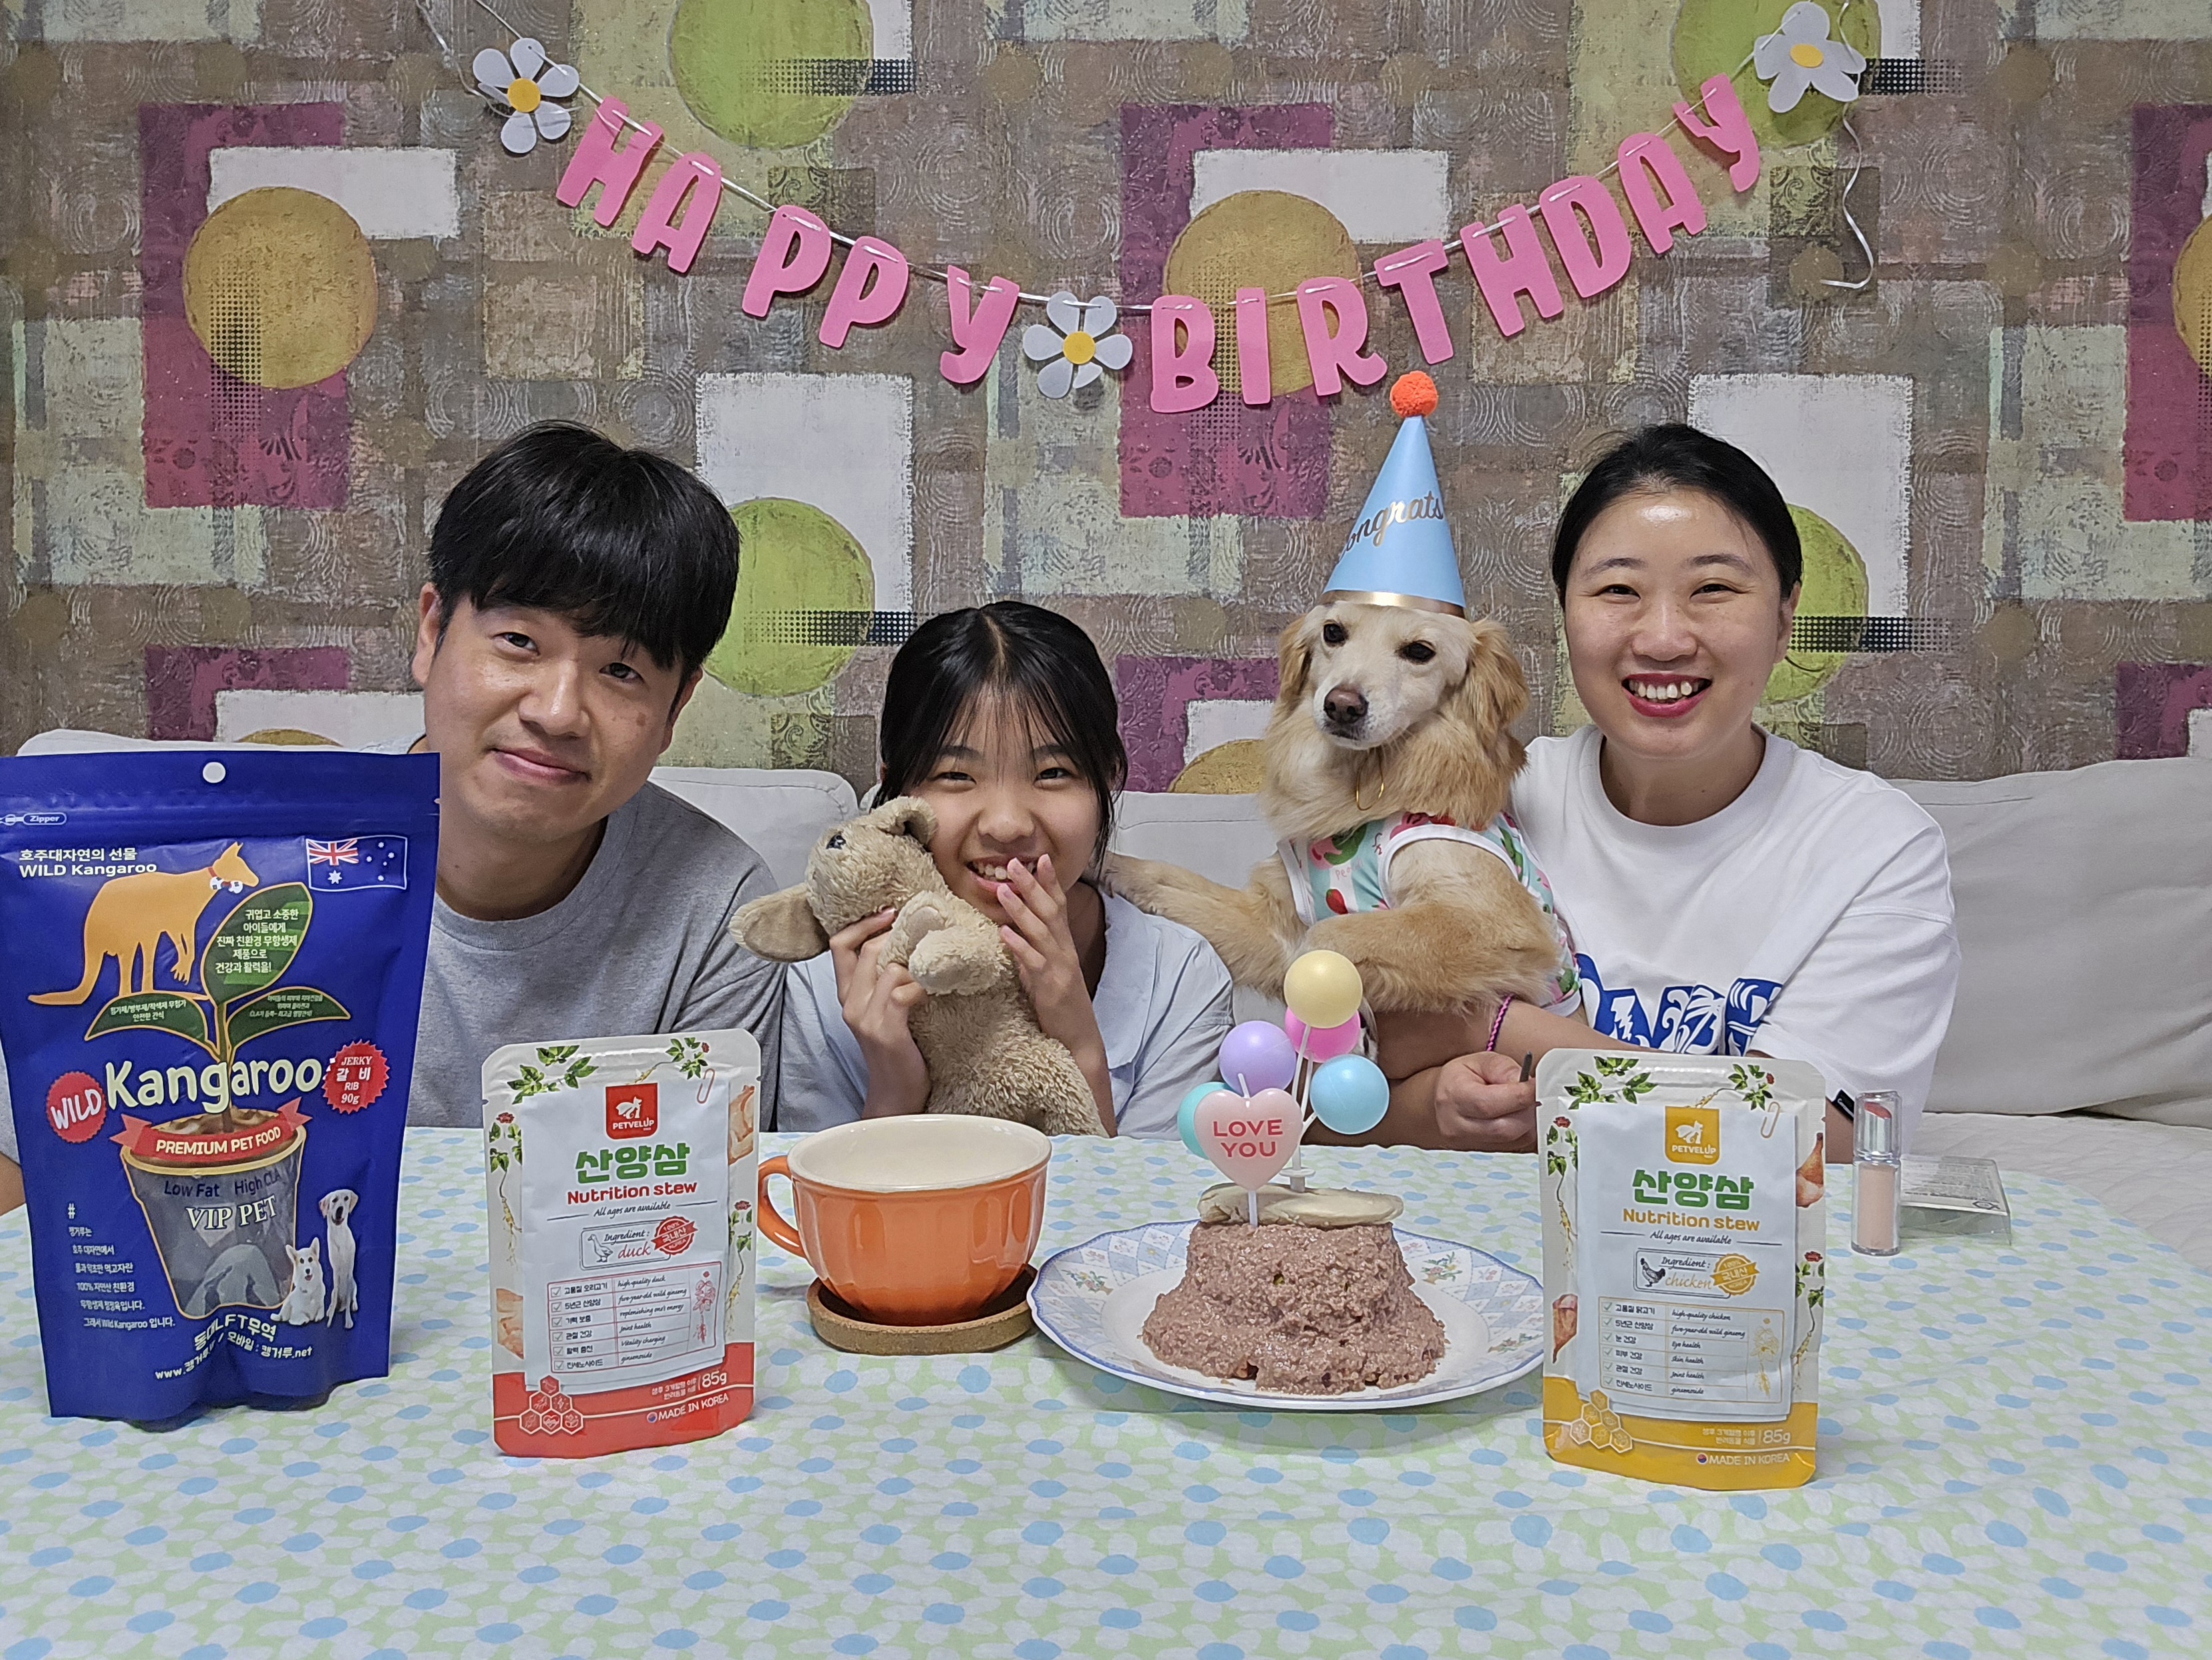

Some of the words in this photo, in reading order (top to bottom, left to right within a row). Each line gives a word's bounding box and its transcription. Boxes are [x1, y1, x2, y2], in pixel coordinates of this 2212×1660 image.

[556, 96, 1019, 384] HAPPY
[1150, 73, 1761, 414] BIRTHDAY
[1337, 491, 1444, 565] ongrats
[19, 849, 104, 861] 호주대자연의
[108, 847, 138, 861] 선물
[19, 865, 66, 878] WILD
[72, 864, 157, 877] Kangaroo
[245, 909, 272, 921] 귀엽고
[273, 909, 299, 921] 소중한
[243, 923, 286, 933] 아이들에게
[216, 936, 234, 947] 진짜
[236, 935, 262, 947] 친환경
[263, 934, 297, 946] 무항생제
[232, 948, 268, 960] 제품으로
[215, 962, 242, 974] 건강과
[244, 962, 272, 973] 활력을!
[341, 1056, 373, 1066] JERKY
[337, 1068, 349, 1082] 갈
[359, 1067, 371, 1081] 비
[105, 1058, 322, 1114] Kangaroo
[344, 1082, 359, 1091] RIB
[341, 1093, 360, 1105] 90g
[51, 1089, 102, 1130] WILD
[613, 1117, 654, 1130] PETVELUP
[1213, 1119, 1283, 1137] LOVE
[156, 1133, 228, 1155] PREMIUM
[230, 1130, 253, 1152] PET
[256, 1126, 281, 1147] FOOD
[1220, 1141, 1276, 1157] YOU
[1672, 1144, 1716, 1154] PETVELUP
[575, 1143, 690, 1184] 산양삼
[164, 1180, 193, 1197] Low
[196, 1183, 220, 1197] Fat
[234, 1176, 262, 1195] High
[264, 1167, 281, 1186] CLA
[568, 1186, 649, 1205] Nutrition
[653, 1182, 697, 1197] stew
[1632, 1169, 1754, 1211] 산양삼
[186, 1207, 232, 1229] VIP
[238, 1195, 277, 1227] PET
[594, 1208, 606, 1217] All
[607, 1209, 622, 1219] ages
[638, 1201, 671, 1211] available
[1623, 1208, 1710, 1228] Nutrition
[1714, 1216, 1760, 1231] stew
[661, 1229, 687, 1243] 국내산
[1664, 1233, 1680, 1244] ages
[1696, 1235, 1732, 1245] available
[618, 1241, 651, 1259] duck
[1665, 1272, 1712, 1289] chicken
[1722, 1267, 1748, 1281] 국내산
[584, 1282, 608, 1292] 오리고기
[618, 1277, 651, 1289] high-quality
[564, 1301, 582, 1310] 5년근
[1672, 1309, 1708, 1321] high-quality
[114, 1320, 148, 1331] Kangaroo
[148, 1316, 176, 1329] 입니다.
[634, 1321, 651, 1330] health
[1615, 1319, 1632, 1328] 5년근
[228, 1331, 255, 1351] 모바일
[580, 1330, 592, 1339] 건강
[1624, 1335, 1636, 1344] 건강
[1672, 1341, 1681, 1350] Eye
[1630, 1351, 1642, 1360] 건강
[1630, 1366, 1642, 1375] 건강
[1686, 1370, 1704, 1379] health
[702, 1370, 727, 1388] 85g
[658, 1404, 687, 1421] MADE
[688, 1401, 699, 1413] IN
[701, 1392, 729, 1410] KOREA
[1763, 1429, 1791, 1444] 85g
[1709, 1455, 1741, 1465] MADE
[1744, 1456, 1755, 1465] IN
[1759, 1453, 1790, 1464] KOREA
